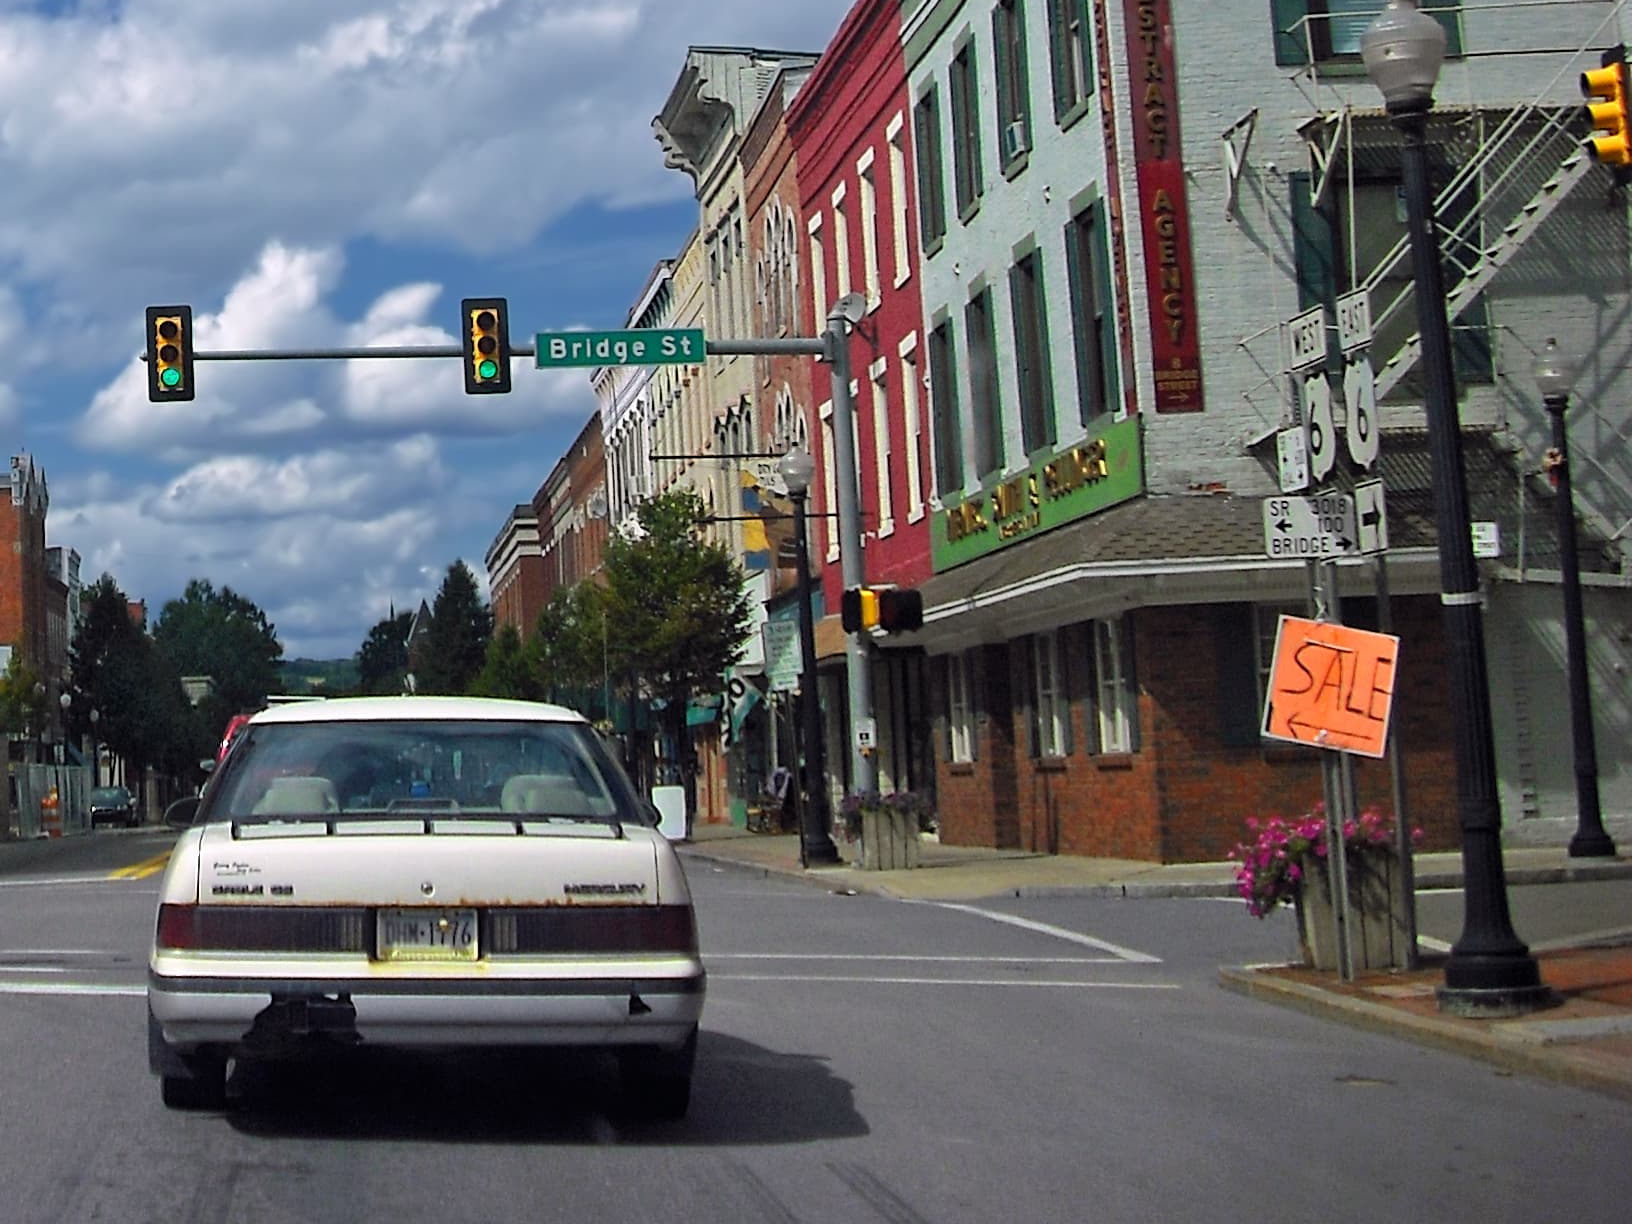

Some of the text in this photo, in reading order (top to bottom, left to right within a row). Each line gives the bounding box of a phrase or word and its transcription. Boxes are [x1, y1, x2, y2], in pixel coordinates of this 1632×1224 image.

[1152, 187, 1183, 346] AGENCY
[1294, 319, 1321, 358] WEST
[1340, 299, 1365, 340] EAST
[549, 335, 692, 364] Bridge St
[1310, 400, 1323, 456] 6
[1357, 384, 1369, 443] 6
[1270, 498, 1347, 517] SR 3018
[1319, 516, 1344, 533] 100
[1273, 536, 1330, 554] BRIDGE
[1279, 641, 1393, 722] SALE
[563, 883, 646, 895] MERCURY
